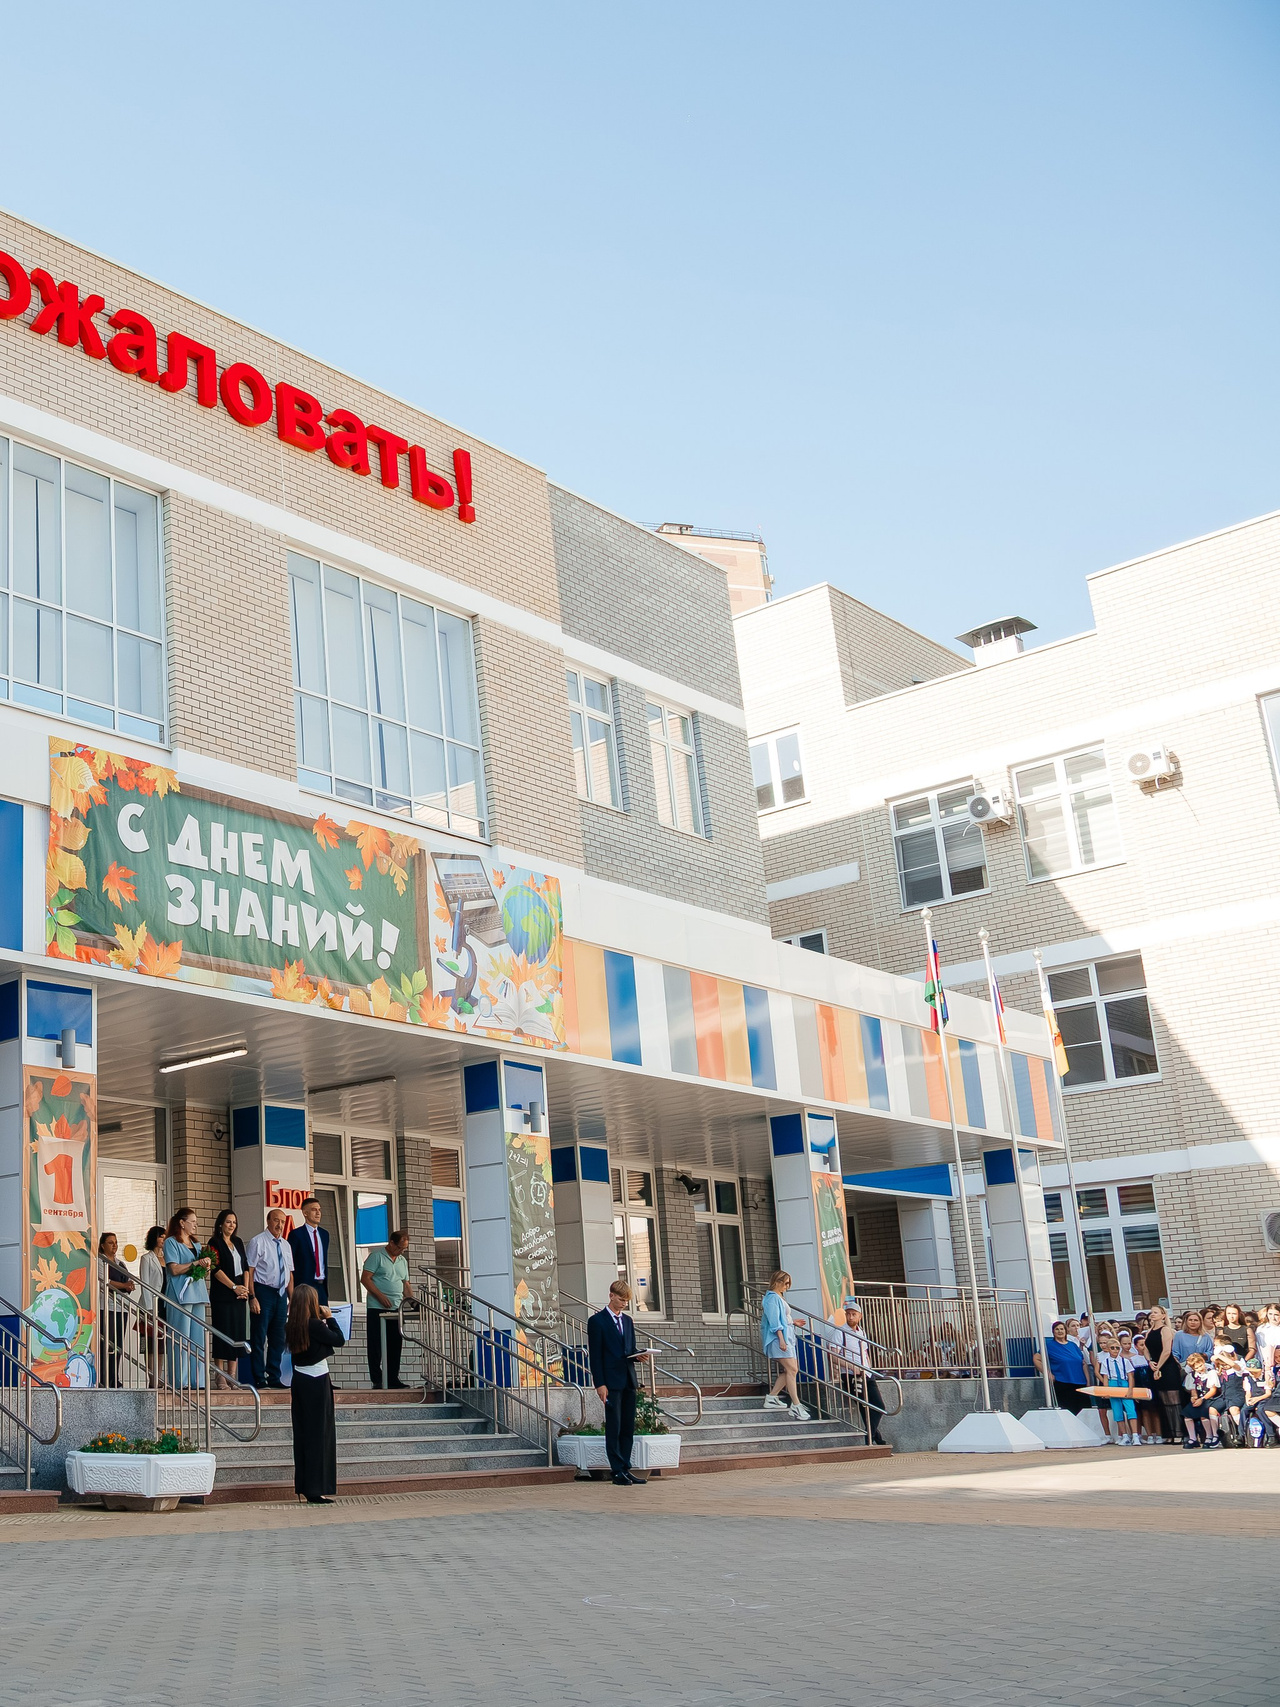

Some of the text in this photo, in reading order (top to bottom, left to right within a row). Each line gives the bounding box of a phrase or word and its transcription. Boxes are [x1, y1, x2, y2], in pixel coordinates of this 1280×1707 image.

[117, 802, 315, 896] С ДНЕМ
[166, 873, 400, 970] ЗНАНИЙ!
[43, 1153, 74, 1205] 1
[508, 1149, 529, 1168] 2+2=4
[43, 1208, 84, 1219] сентября
